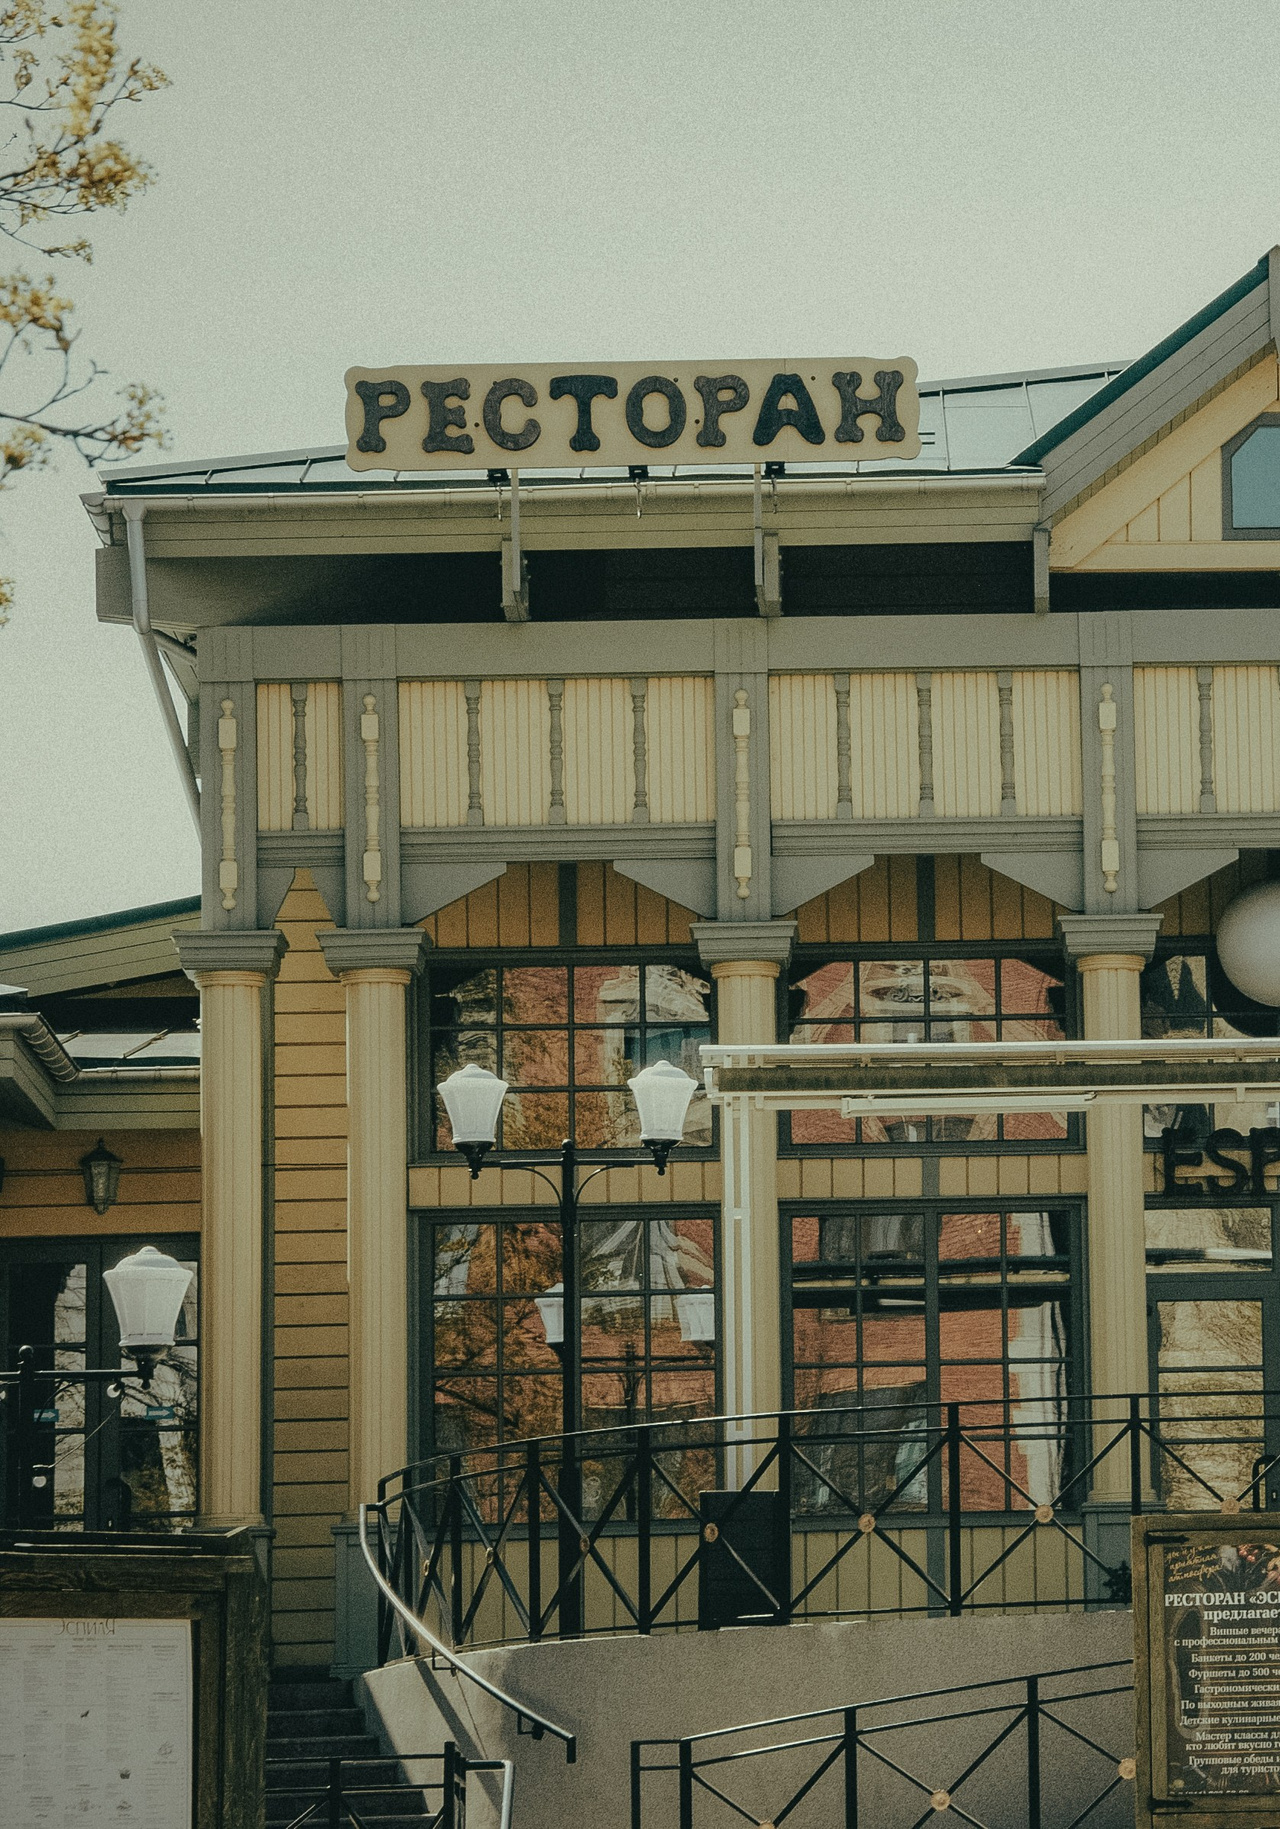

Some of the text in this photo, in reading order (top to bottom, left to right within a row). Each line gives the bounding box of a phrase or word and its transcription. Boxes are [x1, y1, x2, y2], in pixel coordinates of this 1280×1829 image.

[354, 370, 906, 454] РЕСТОРАН
[1164, 1591, 1245, 1607] РЕСТОРАН
[1210, 1627, 1249, 1636] Винные
[1182, 1636, 1278, 1648] профессиональным
[1191, 1653, 1233, 1663] Банкеты
[1234, 1654, 1247, 1662] до
[1248, 1652, 1267, 1661] 200
[1188, 1668, 1236, 1680] Фуршеты
[1237, 1669, 1250, 1678] до
[1252, 1667, 1270, 1676] 500
[1181, 1700, 1195, 1709] По
[1197, 1700, 1249, 1709] выходным
[1179, 1715, 1220, 1726] Детские
[1195, 1731, 1232, 1742] Мастер
[1234, 1731, 1268, 1739] классы
[1185, 1743, 1202, 1751] кто
[1204, 1741, 1236, 1750] любит
[1238, 1741, 1272, 1751] вкусно
[1188, 1755, 1242, 1767] Групповые
[1243, 1753, 1274, 1764] обеды
[1220, 1766, 1238, 1775] для
